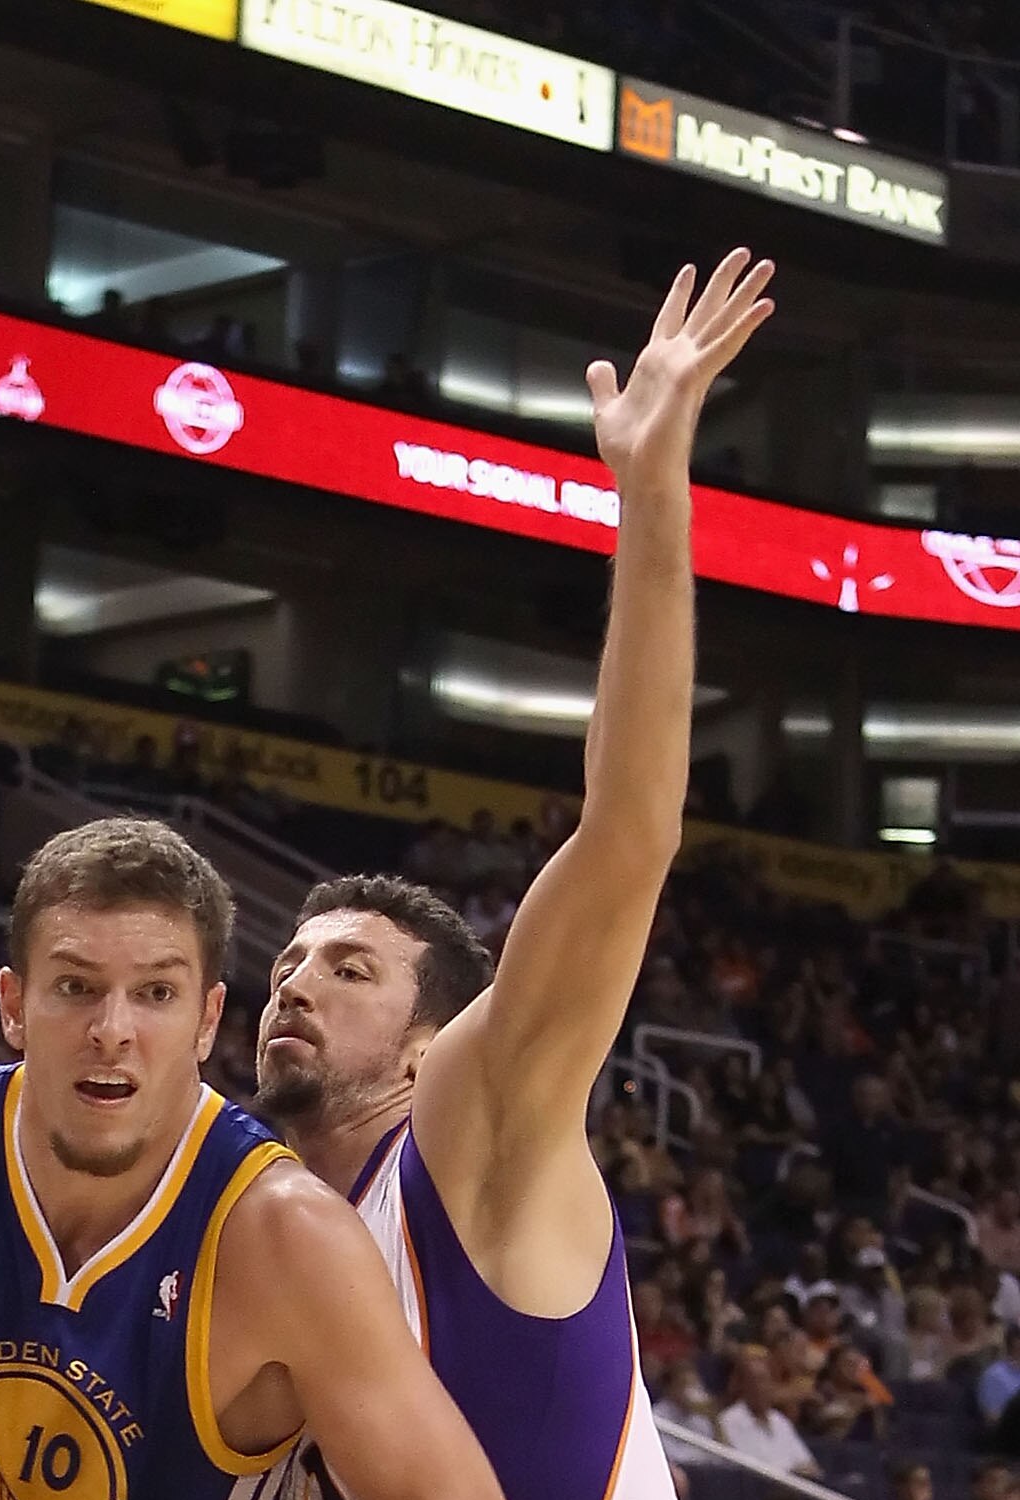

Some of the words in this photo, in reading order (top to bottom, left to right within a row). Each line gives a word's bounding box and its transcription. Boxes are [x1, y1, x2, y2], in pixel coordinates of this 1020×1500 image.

[354, 757, 428, 806] 104
[64, 1359, 146, 1448] STATE
[17, 1423, 83, 1493] 10
